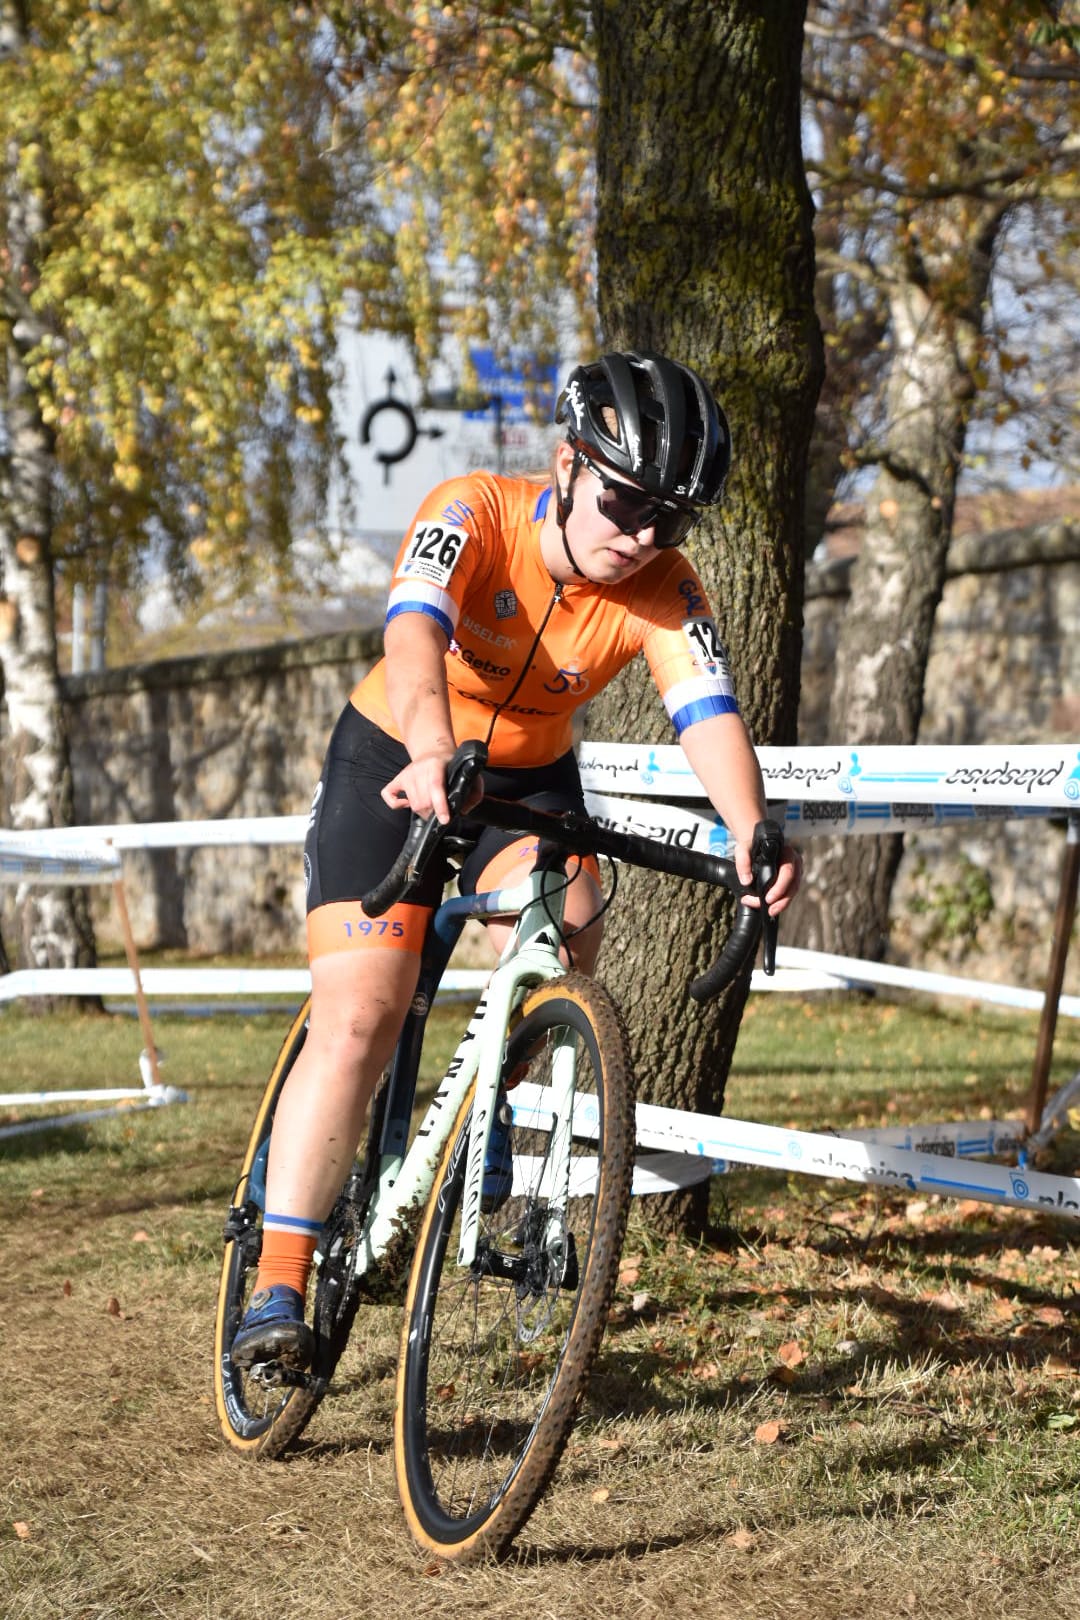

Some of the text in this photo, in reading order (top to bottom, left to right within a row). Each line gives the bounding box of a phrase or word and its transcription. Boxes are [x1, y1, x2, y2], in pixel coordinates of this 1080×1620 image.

[411, 527, 462, 569] 126
[461, 649, 511, 676] Getxo
[945, 760, 1065, 793] plaspisa
[344, 921, 404, 937] 1975
